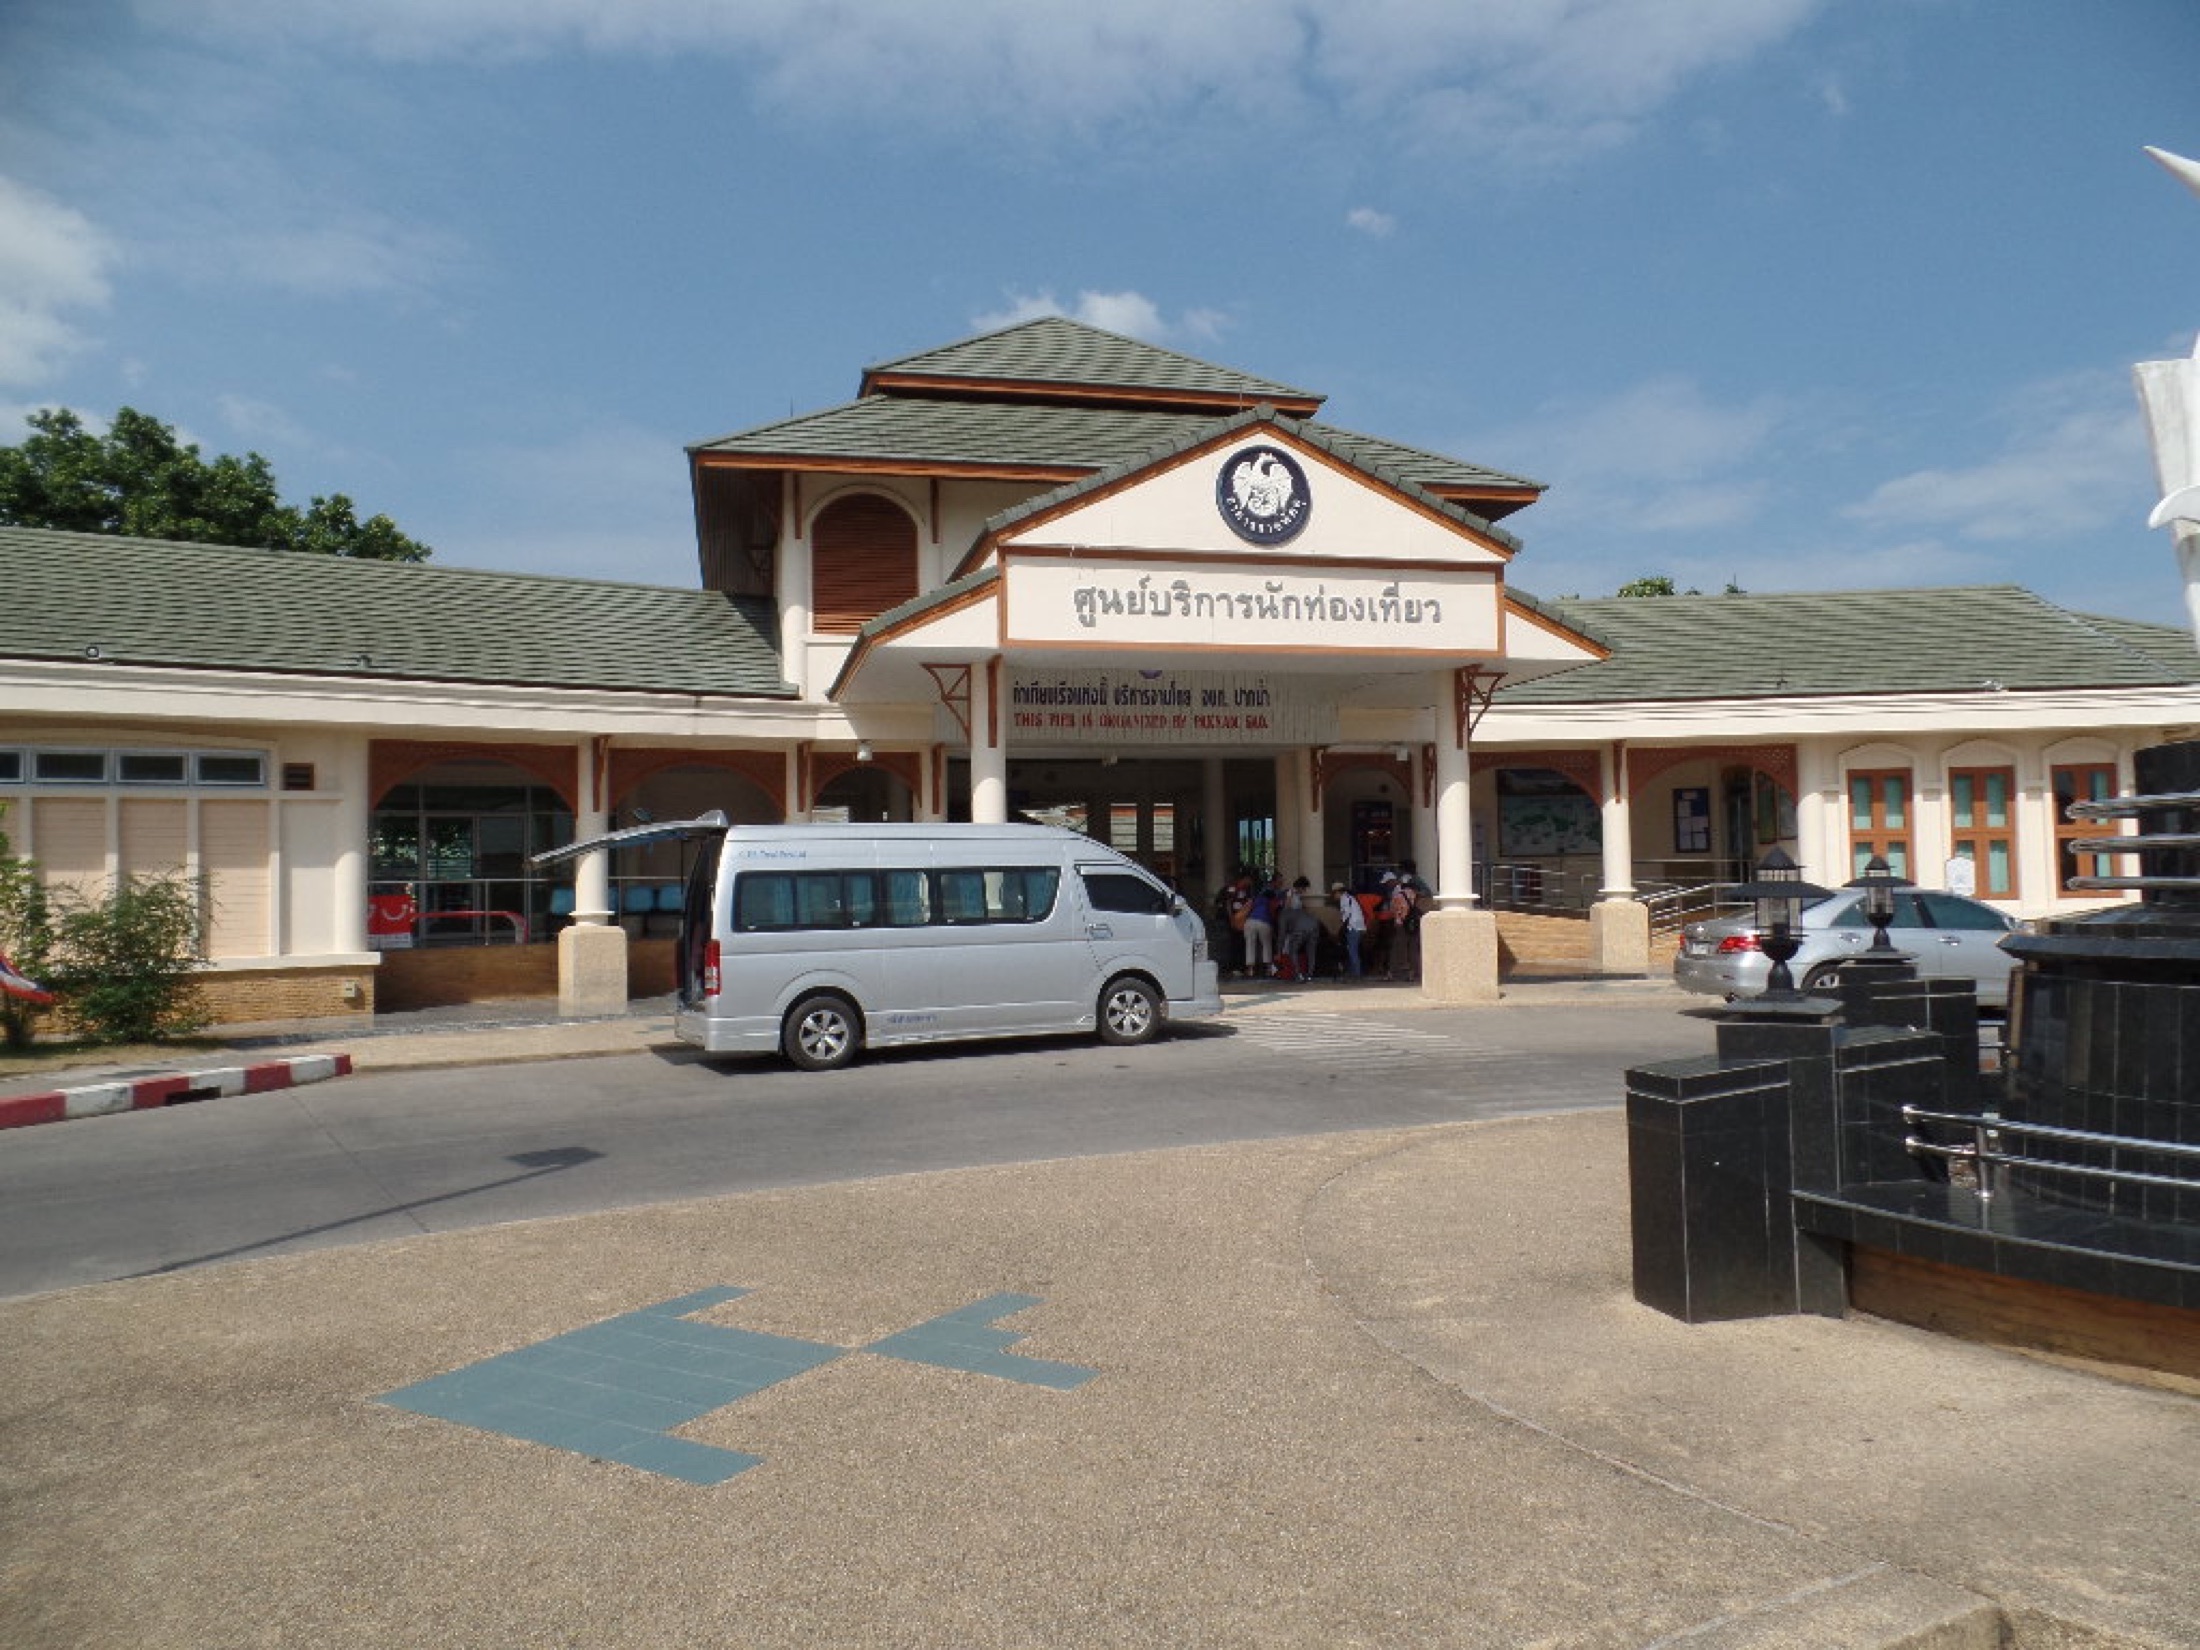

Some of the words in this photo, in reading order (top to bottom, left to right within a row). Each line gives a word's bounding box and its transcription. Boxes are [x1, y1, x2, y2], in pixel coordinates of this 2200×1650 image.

[1074, 575, 1442, 628] ศูนย์บริการนักท่องเที่ยว
[1014, 713, 1042, 727] THIS
